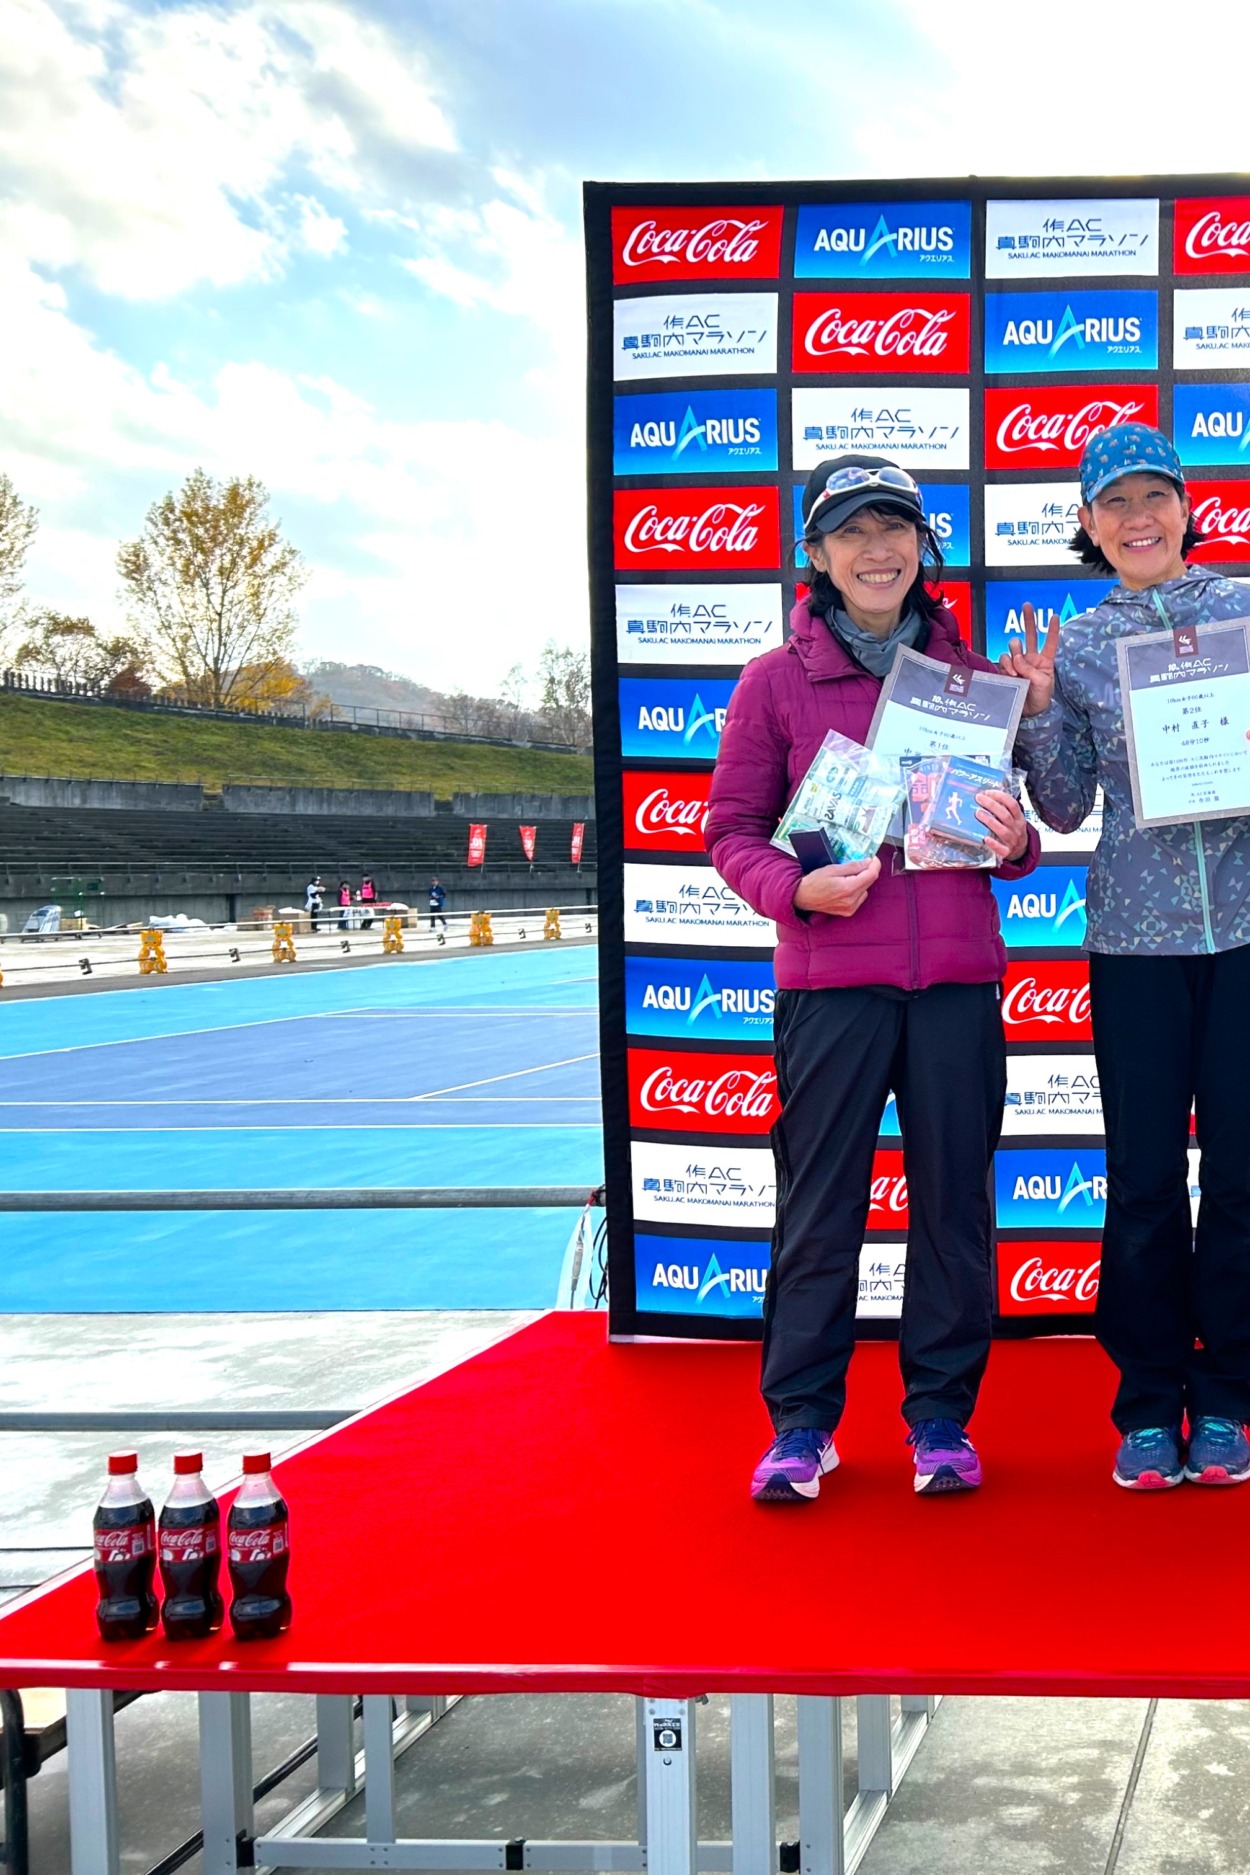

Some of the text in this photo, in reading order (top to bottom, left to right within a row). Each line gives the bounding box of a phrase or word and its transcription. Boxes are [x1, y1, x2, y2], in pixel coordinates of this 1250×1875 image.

[623, 220, 768, 266] Coca-Cola
[813, 213, 953, 266] AQUARIUS
[995, 233, 1149, 250] 真駒内マラソン
[1042, 250, 1089, 258] MAKOMANAI
[1090, 249, 1136, 257] MARATHON
[621, 330, 767, 351] 真駒内マラソン
[663, 348, 709, 357] MAKOMANAI
[709, 347, 754, 355] MARATHON
[804, 308, 956, 356] Coca-Cola
[1002, 303, 1141, 359] AQUARIUS
[1107, 345, 1141, 353] アクエリアス
[630, 405, 760, 461] AQUARIUS
[802, 425, 959, 441] 真駒内マラソン
[996, 401, 1144, 453] Coca-C
[624, 503, 766, 552] Coca-Cola
[1041, 537, 1072, 546] MAKOM
[625, 619, 773, 634] 真駒内マラソン
[638, 691, 728, 746] AQUAR
[1182, 706, 1202, 715] 第2位
[635, 788, 708, 835] Coca-
[633, 899, 753, 915] 真駒内マラ
[1007, 879, 1086, 934] AQUA
[642, 972, 775, 1025] AQUARIUS
[1002, 978, 1090, 1023] Coca-C
[640, 1066, 778, 1116] Coca-Cola
[1003, 1089, 1101, 1107] 真駒内マラ
[686, 1197, 732, 1206] MAKOMANAI
[733, 1200, 776, 1208] MARATHON
[1012, 1162, 1107, 1216] AQUAR
[652, 1250, 767, 1303] AQUARIU
[868, 1262, 906, 1277] 作.A
[1010, 1257, 1101, 1301] Coca-C
[94, 1530, 131, 1546] ca-Cola
[229, 1530, 272, 1546] Coca-Cola
